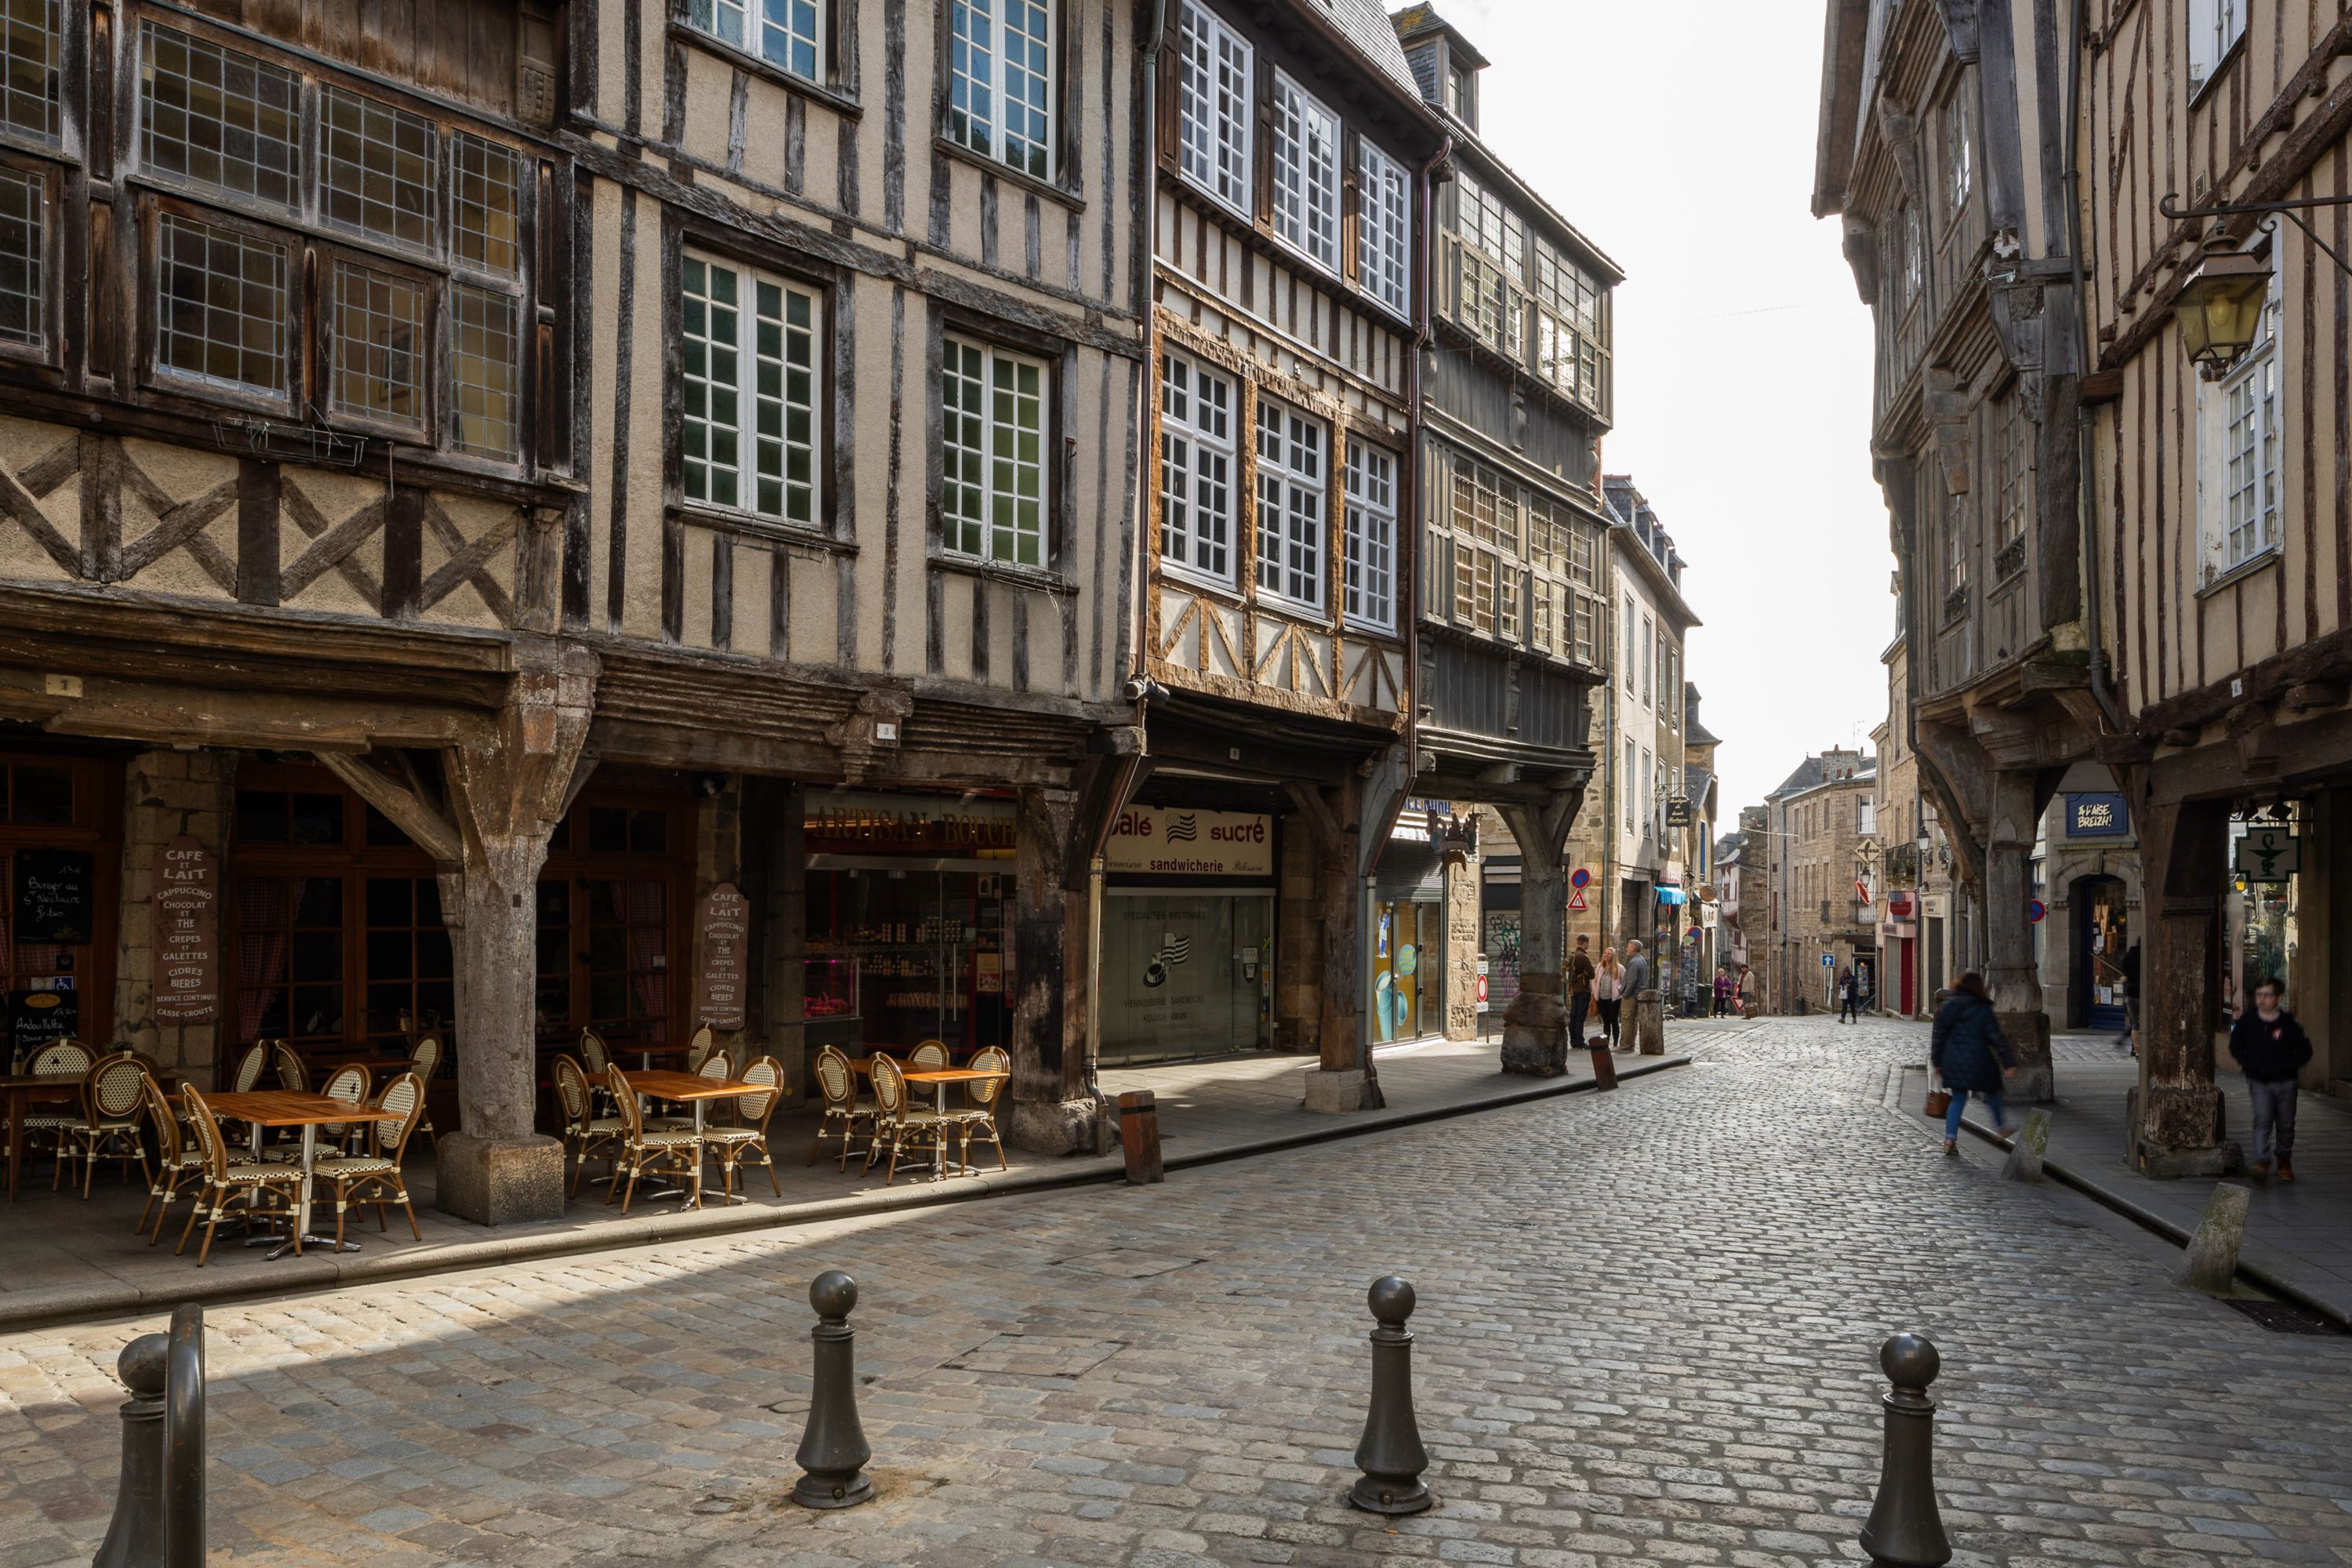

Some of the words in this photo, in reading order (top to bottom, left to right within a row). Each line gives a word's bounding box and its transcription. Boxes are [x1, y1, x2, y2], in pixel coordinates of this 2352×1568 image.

[884, 727, 889, 735] 3
[813, 805, 928, 842] ARTISAN
[1210, 816, 1265, 844] sucré
[165, 850, 204, 862] CAFE
[1150, 858, 1223, 872] sandwicherie
[163, 868, 207, 880] LAIT
[157, 887, 212, 899] CAPPUCCINO
[712, 893, 739, 902] CAFE
[710, 907, 742, 916] LAIT
[176, 919, 195, 929] THE
[704, 922, 744, 932] CAPPUCCINO
[717, 946, 731, 955] THE
[162, 952, 208, 960] GALETTES
[169, 967, 203, 977] CIDRES
[170, 978, 201, 989] BIERES
[710, 984, 735, 993] CIDRES
[710, 993, 733, 1001] BIERES
[157, 1005, 214, 1017] CASSE-CROUTE
[16, 1017, 65, 1030] Andouillette
[699, 1015, 741, 1024] CASSE-CROUTE
